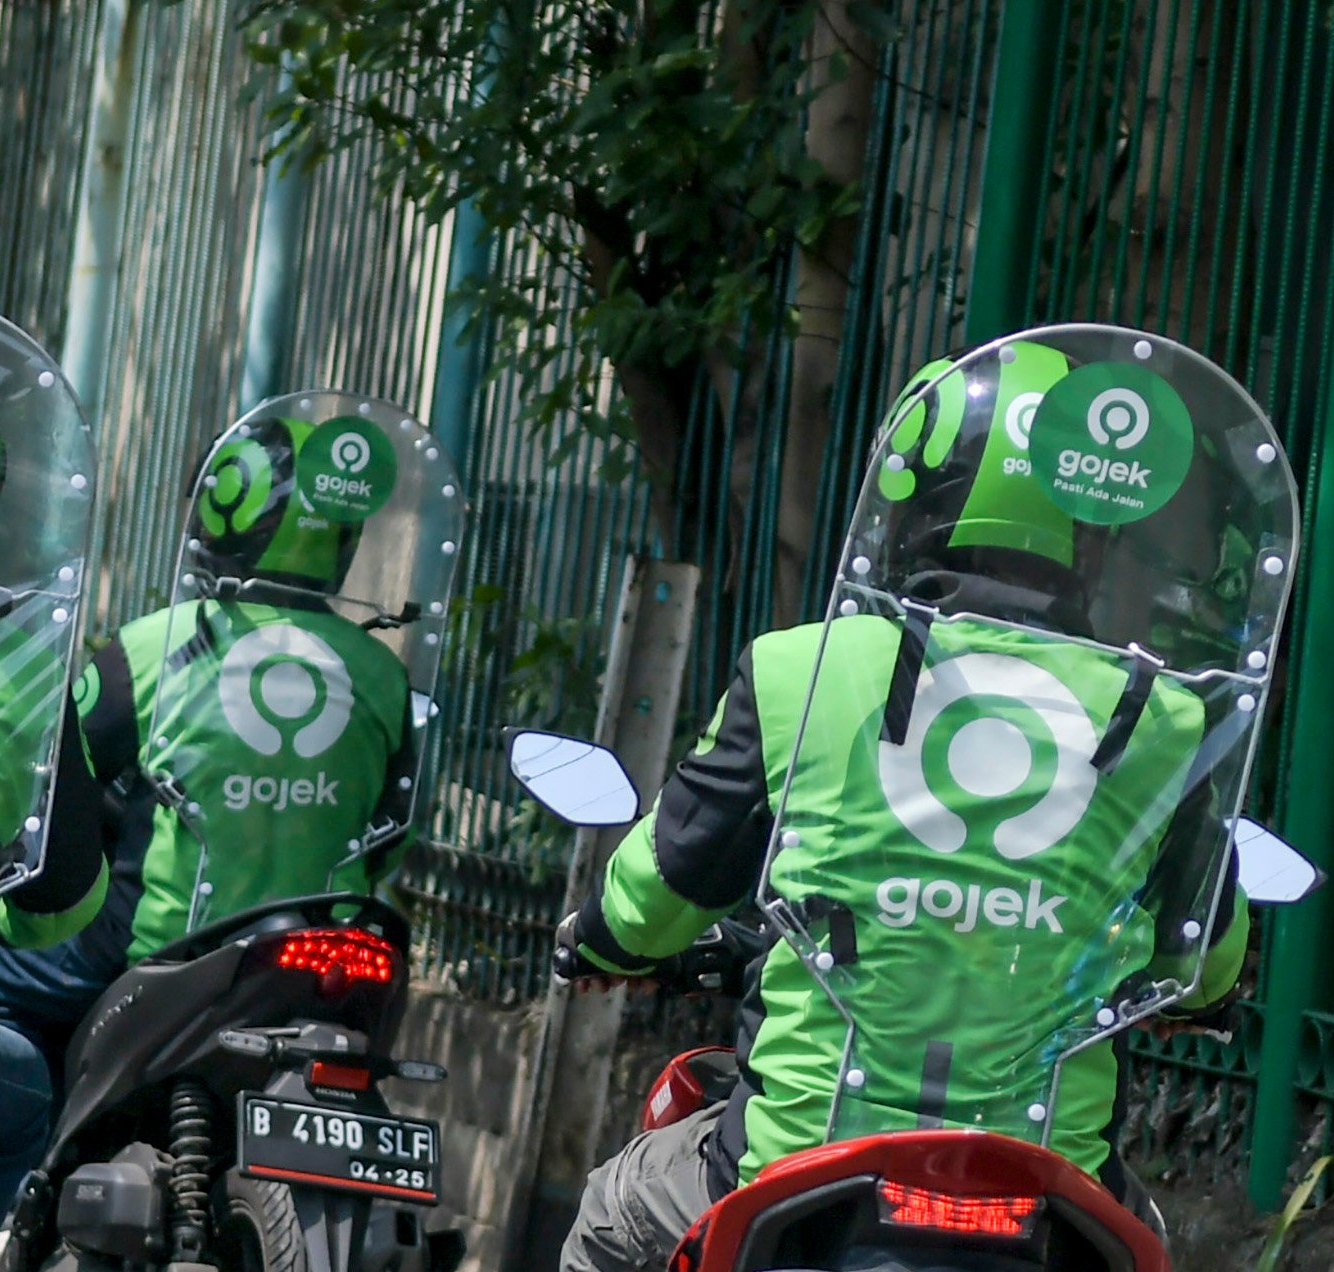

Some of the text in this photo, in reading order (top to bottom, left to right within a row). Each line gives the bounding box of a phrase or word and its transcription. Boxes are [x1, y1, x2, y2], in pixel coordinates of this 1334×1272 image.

[315, 474, 372, 497] gojek
[1003, 457, 1031, 476] goj
[1058, 449, 1151, 488] gojek
[1053, 478, 1144, 509] Pasti Ada Jalan
[224, 771, 339, 811] gojek
[876, 876, 1068, 934] gojek
[254, 1106, 429, 1160] B 4190 SLF
